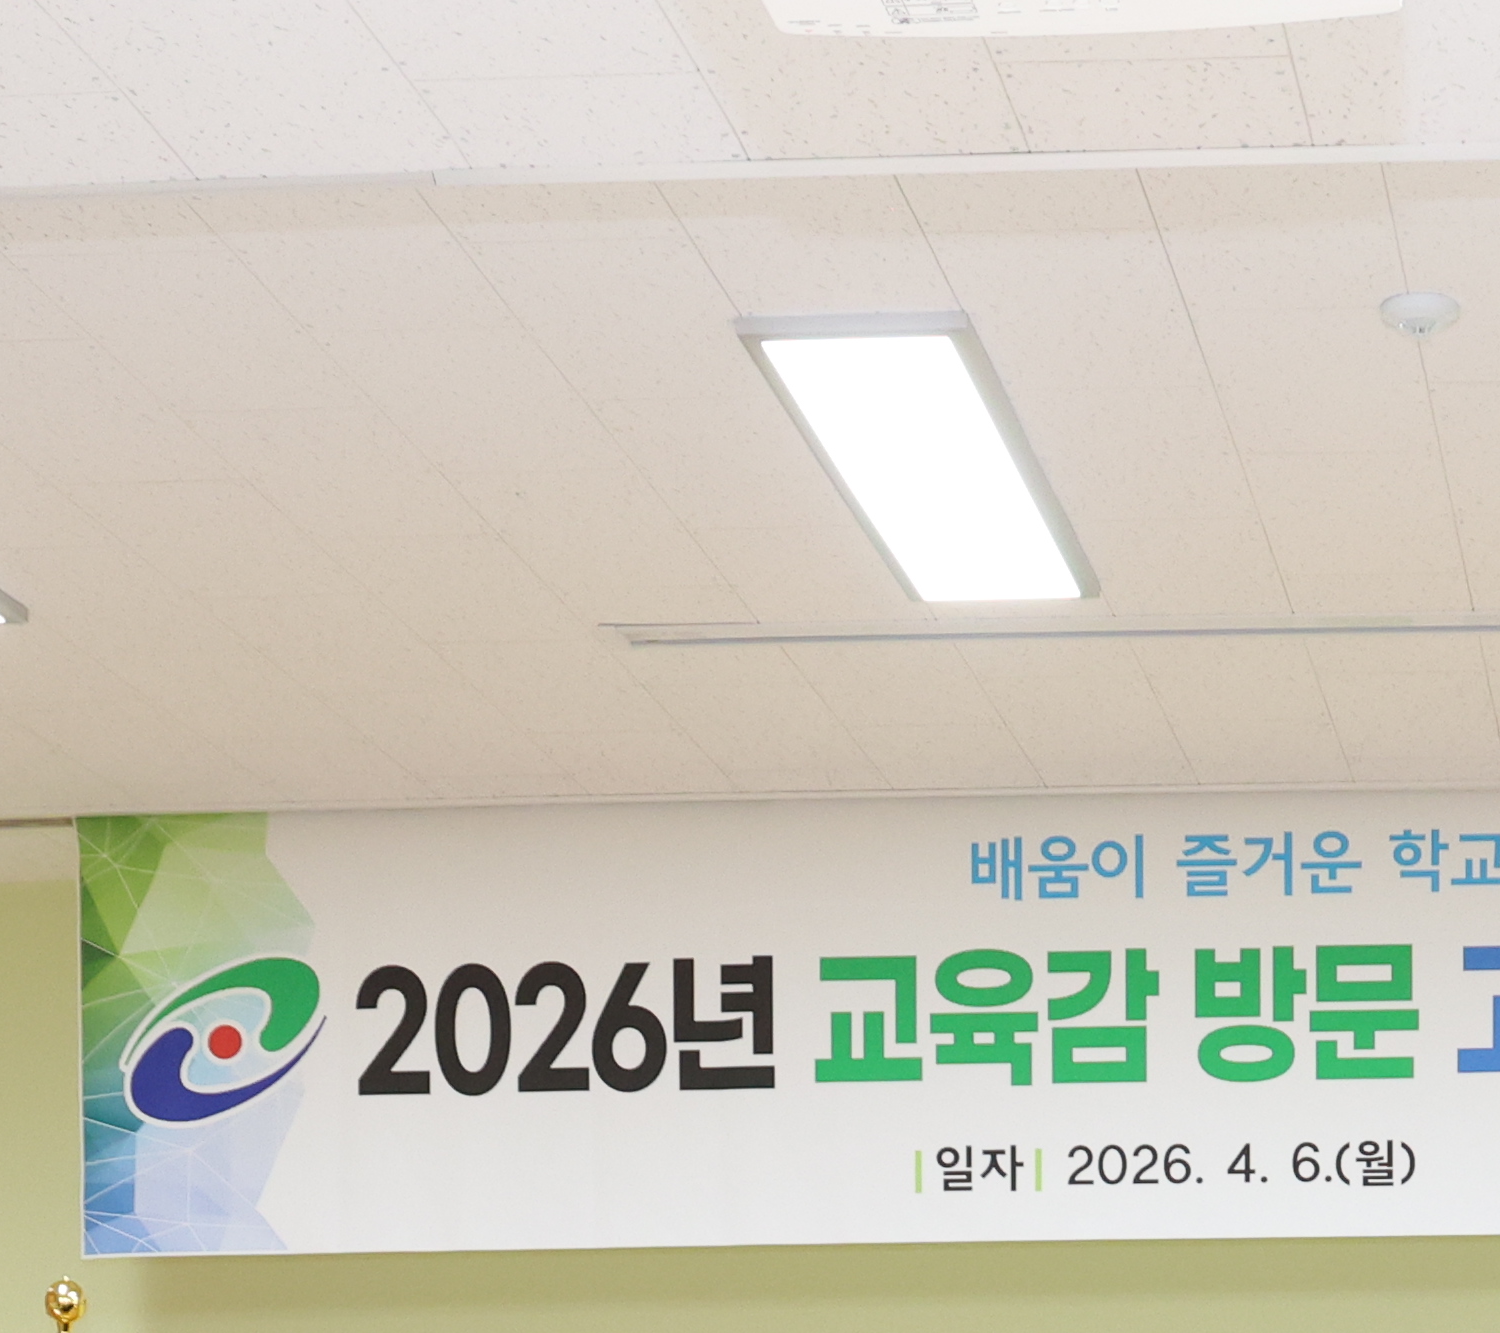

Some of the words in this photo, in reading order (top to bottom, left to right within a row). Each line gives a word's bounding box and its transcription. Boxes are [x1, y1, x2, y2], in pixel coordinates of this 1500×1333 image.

[971, 834, 1144, 901] 배움이
[1176, 830, 1362, 898] 즐거운
[354, 954, 776, 1098] 2026년
[815, 948, 1160, 1087] 교육감
[1195, 944, 1420, 1083] 방문
[935, 1143, 1025, 1193] 일자
[1067, 1142, 1204, 1186] 2026.
[1226, 1142, 1269, 1184] 4.
[1291, 1139, 1417, 1190] 6.(월)
